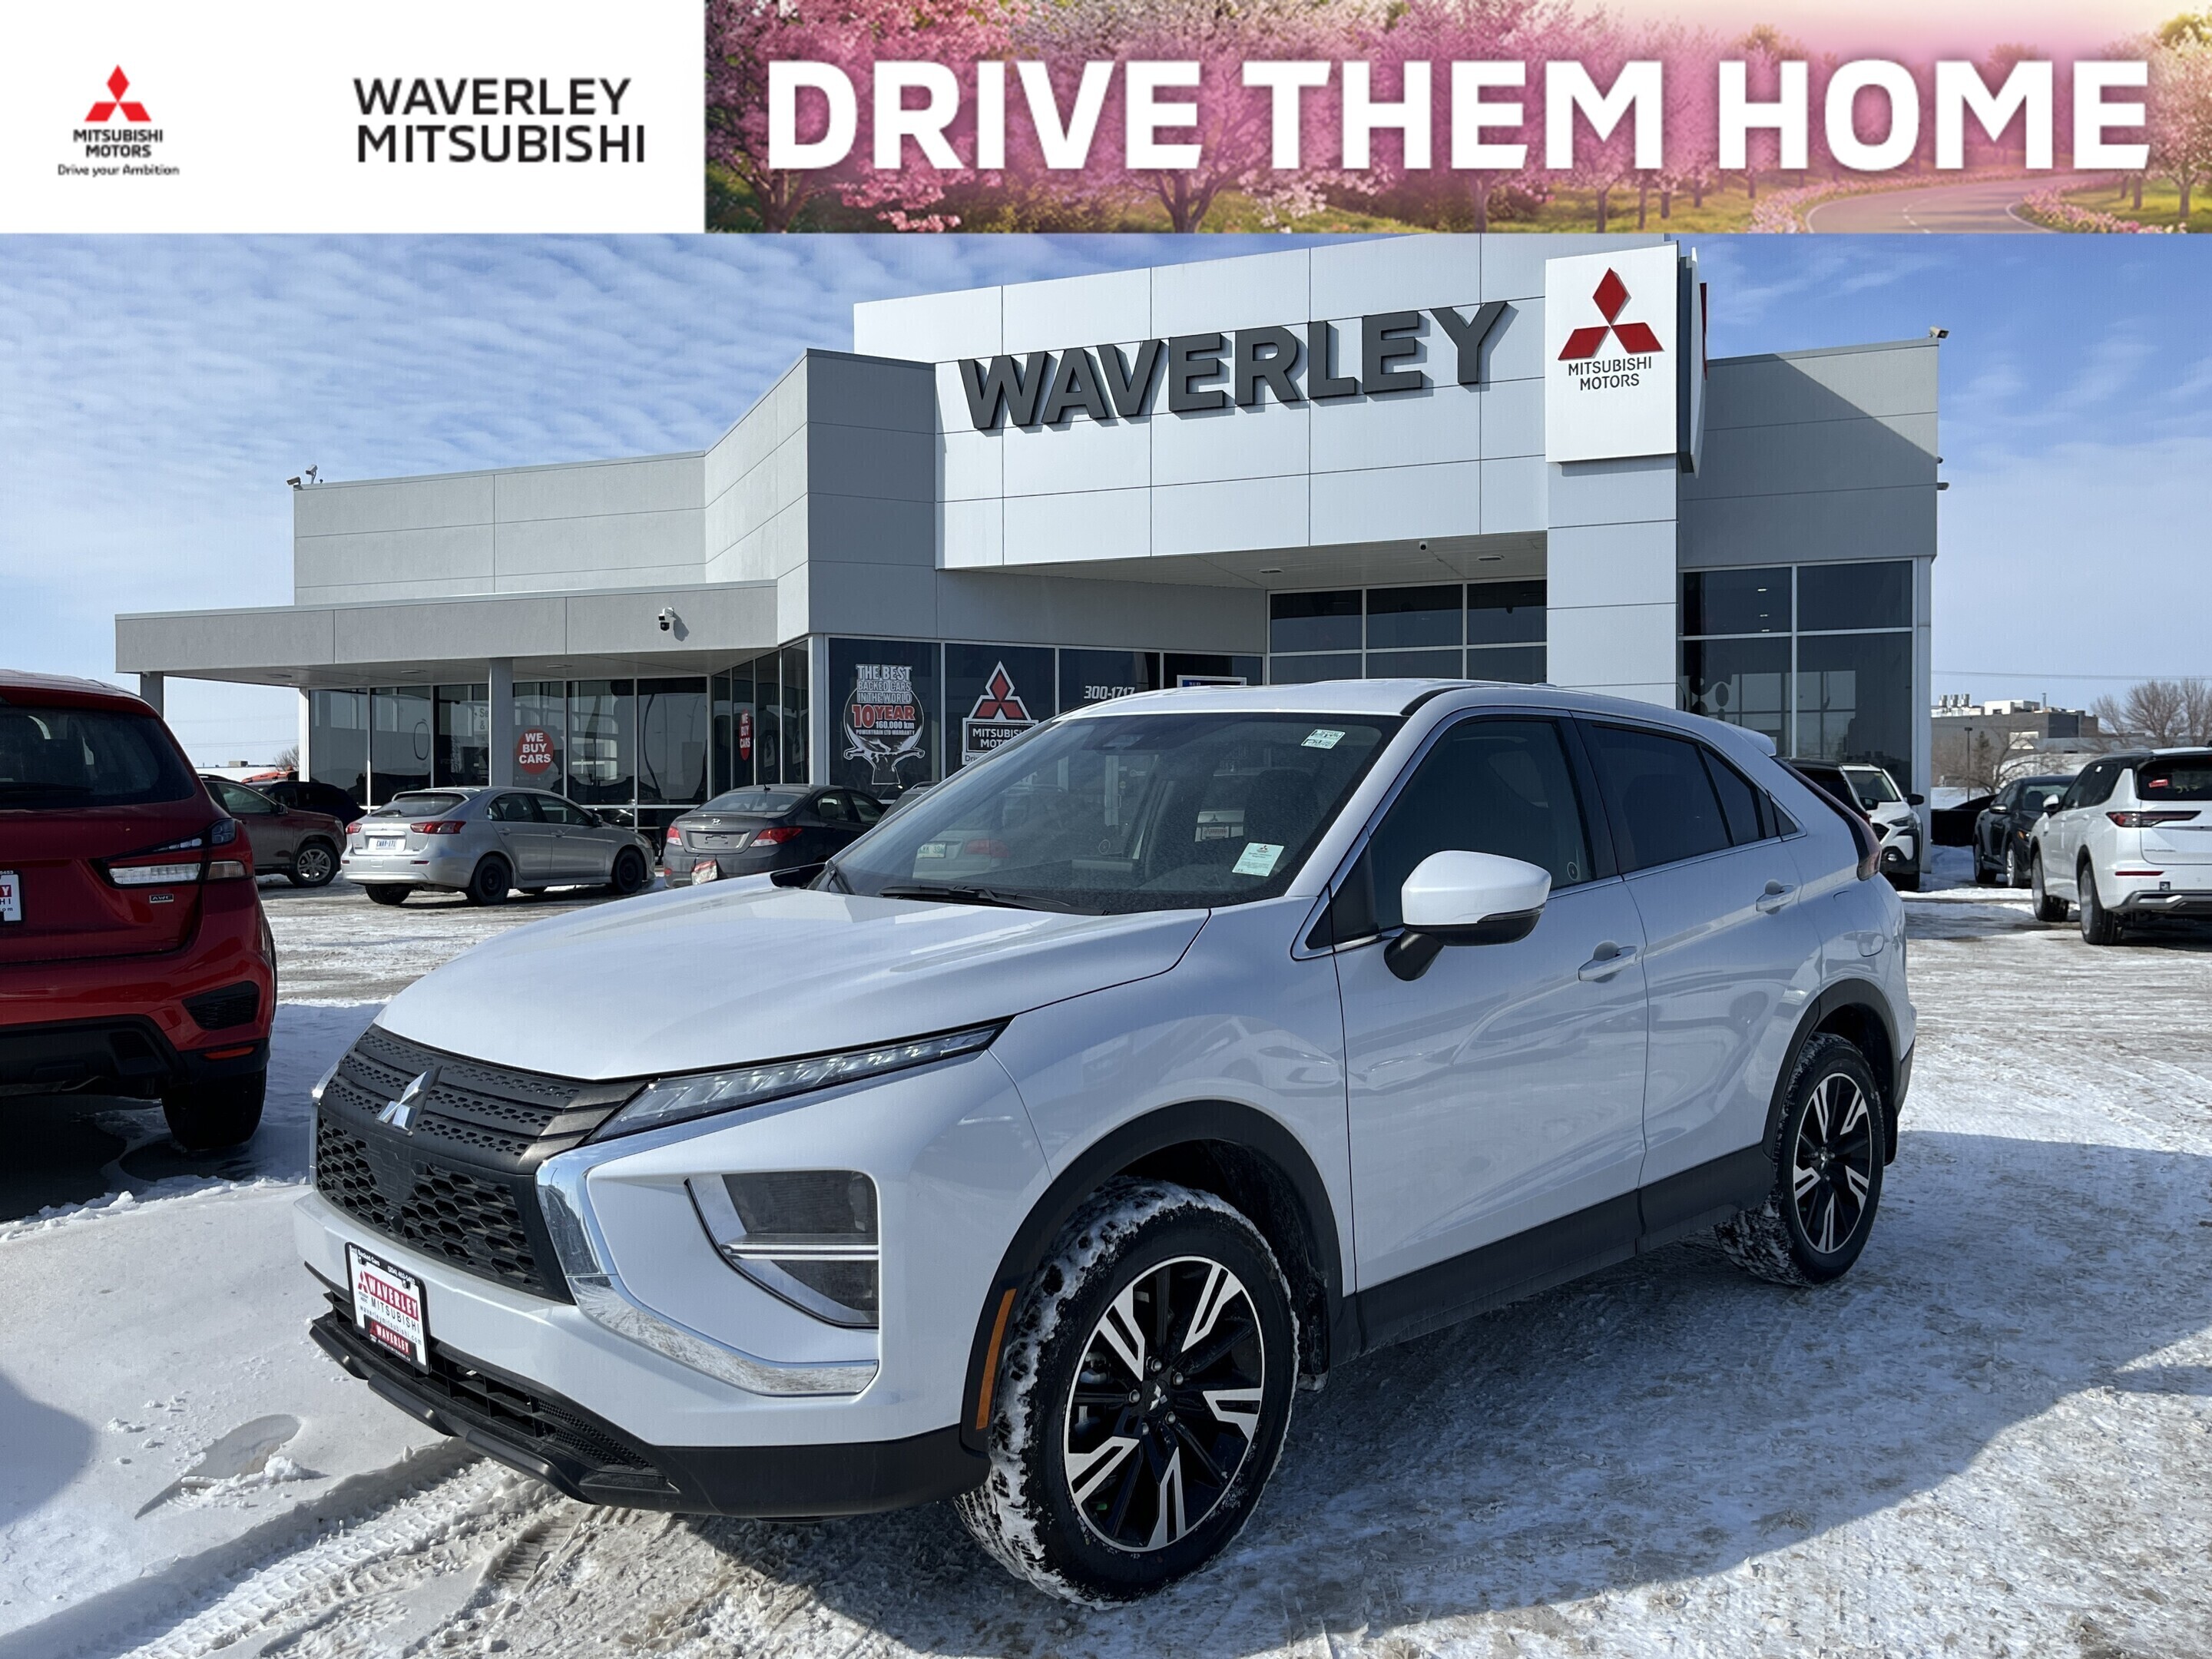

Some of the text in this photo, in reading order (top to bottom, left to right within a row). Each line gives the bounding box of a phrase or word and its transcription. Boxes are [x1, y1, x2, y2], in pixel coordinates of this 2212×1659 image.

[958, 301, 1510, 430] WAVERLEY
[1568, 356, 1652, 376] MITSUBISHI
[1580, 373, 1640, 390] MOTORS
[856, 664, 912, 680] THE BEST
[857, 680, 912, 691] BACKED CARS
[858, 692, 912, 704] IN THE WORLD
[741, 713, 748, 724] WE
[852, 704, 916, 728] 10 YEAR
[740, 725, 750, 737] BUY
[972, 728, 1025, 737] MITSUBIS
[525, 733, 544, 742] WE
[740, 737, 750, 748] CARS
[522, 743, 547, 753] BUY
[518, 754, 551, 763] CARS
[368, 1276, 419, 1319] WAVERLEY
[371, 1296, 420, 1334] MITSUBISHI
[376, 1324, 409, 1353] WAVERLEY
